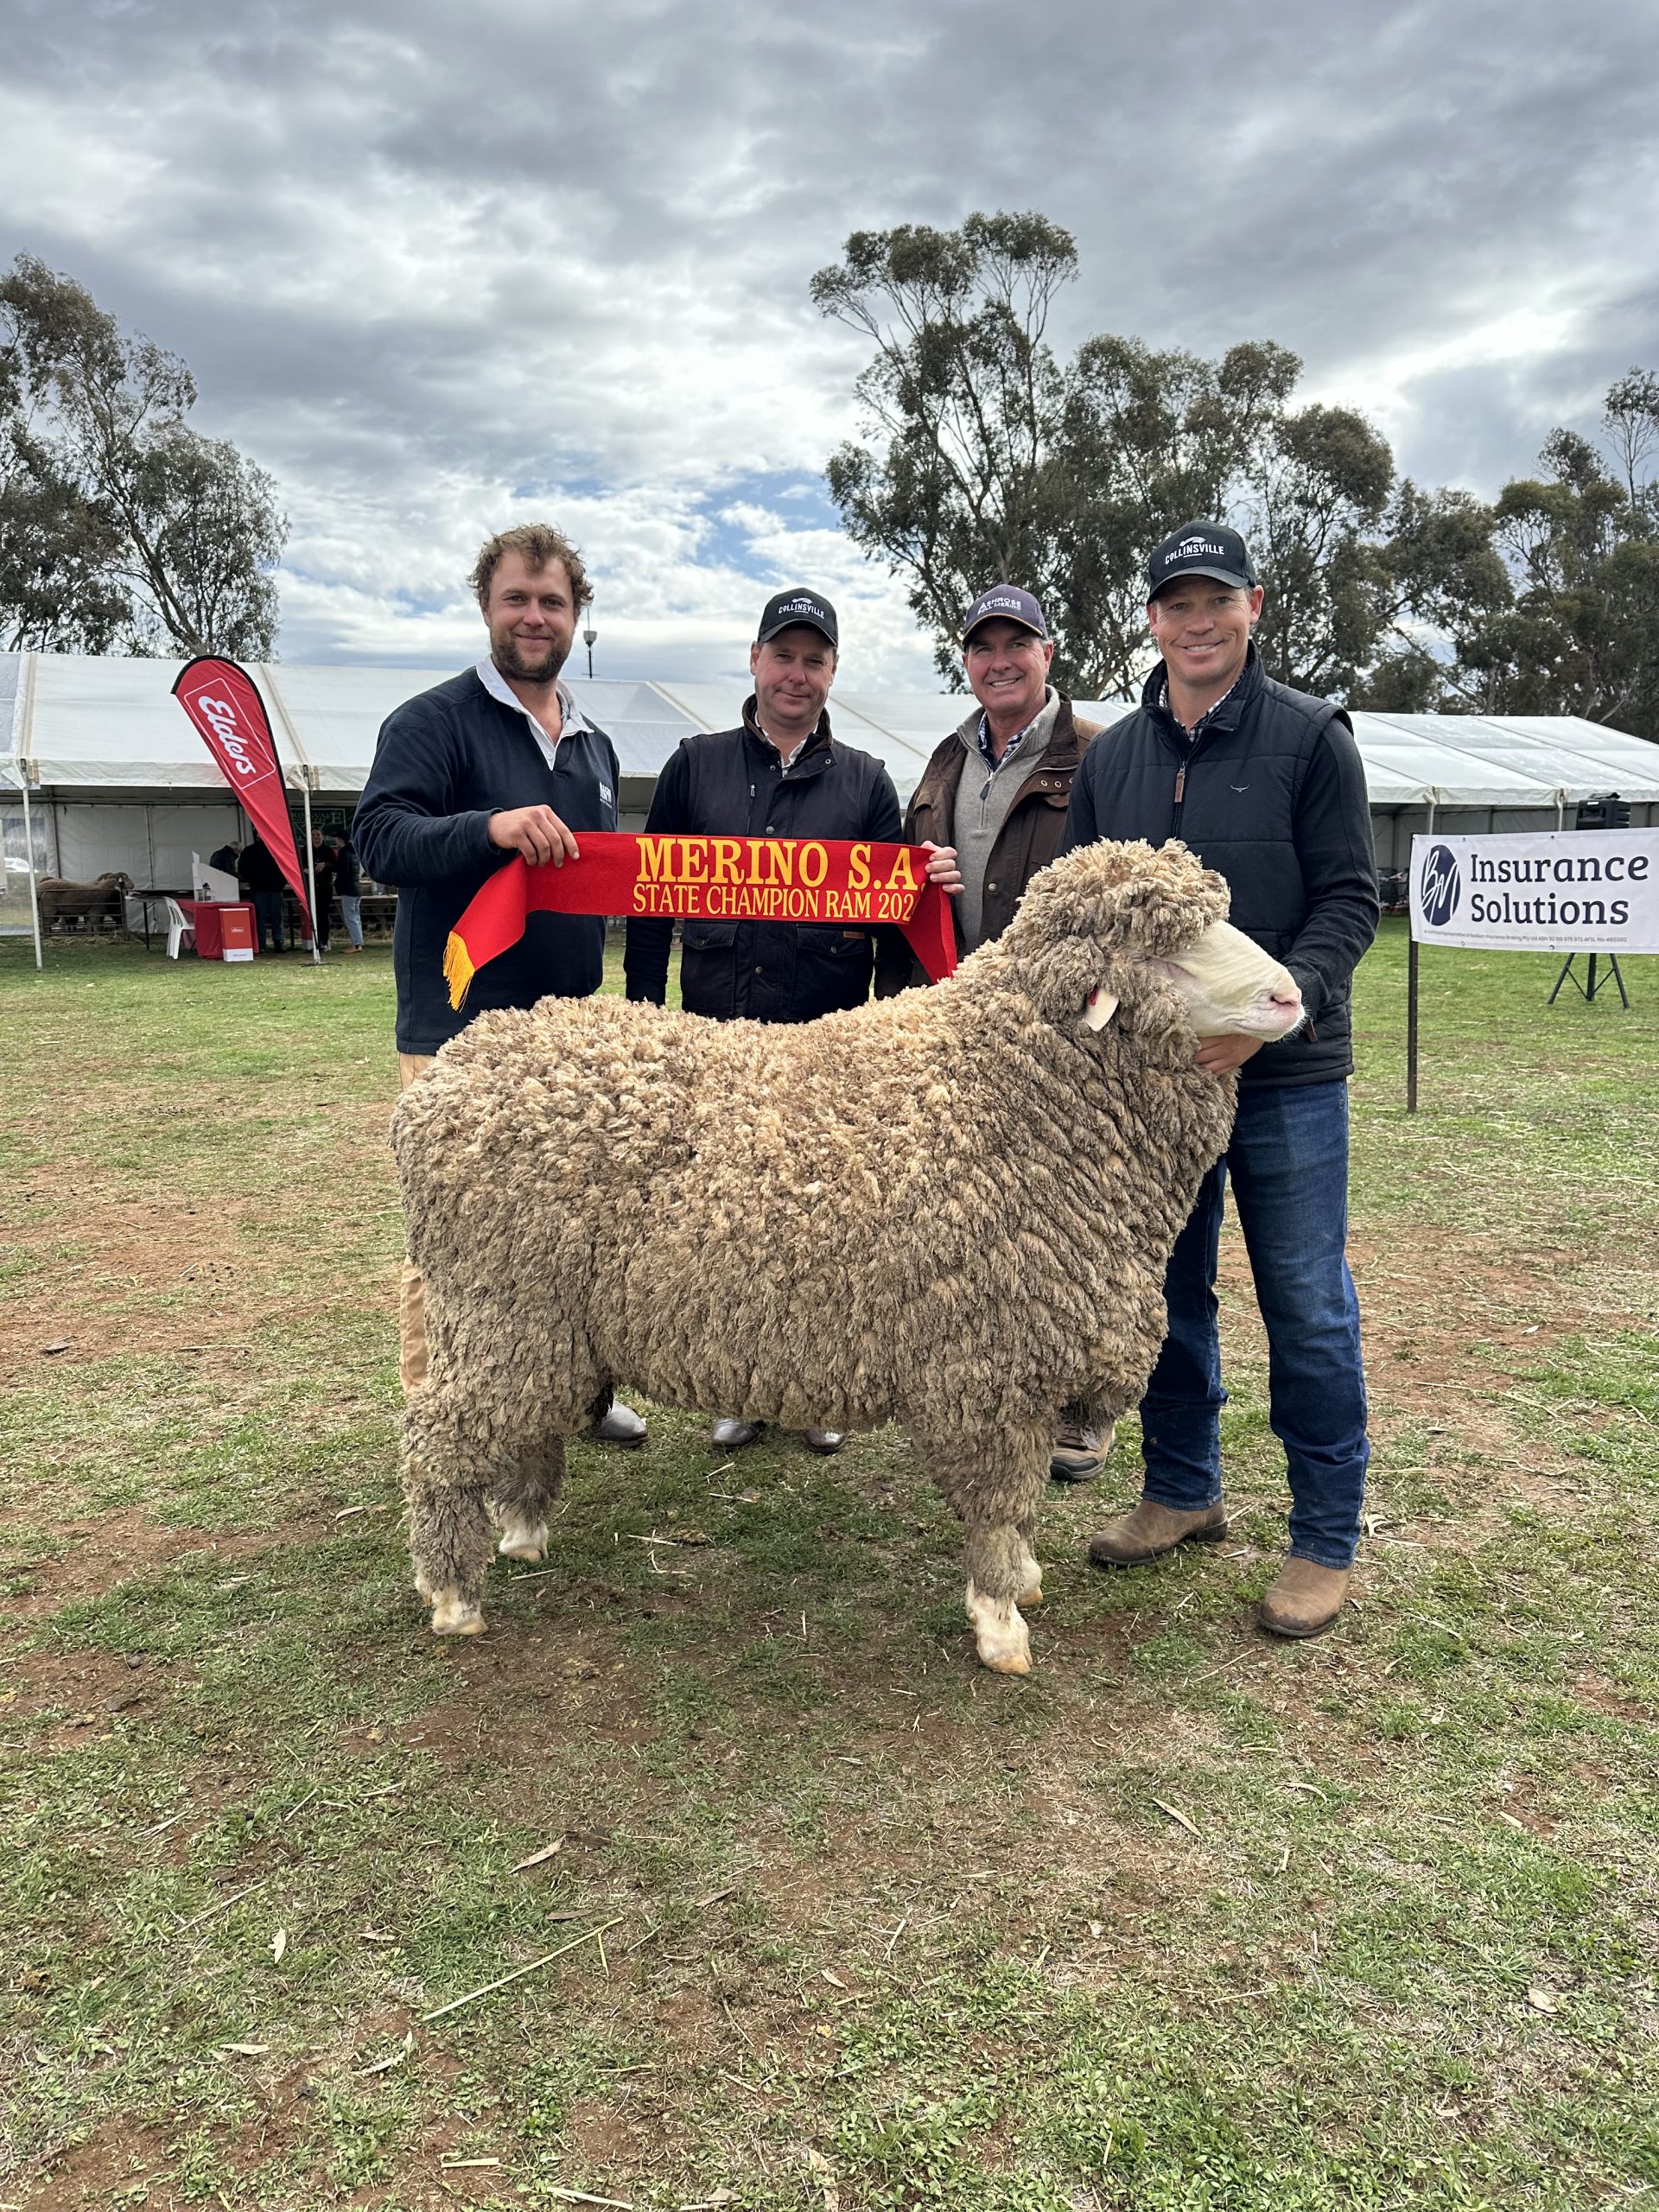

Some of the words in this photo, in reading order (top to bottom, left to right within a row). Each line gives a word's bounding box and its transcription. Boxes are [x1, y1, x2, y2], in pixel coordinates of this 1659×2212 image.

[1165, 543, 1225, 565] COLLINSVILLE
[778, 603, 825, 620] COLLINSVILLE
[978, 597, 1021, 612] ASHROSE
[198, 696, 257, 774] Elders
[635, 837, 829, 887] MERINO
[1471, 855, 1649, 883] Insurance
[632, 882, 701, 913] STATE
[706, 885, 820, 918] CHAMPION
[825, 890, 872, 918] RAM
[1471, 893, 1630, 925] Solutions
